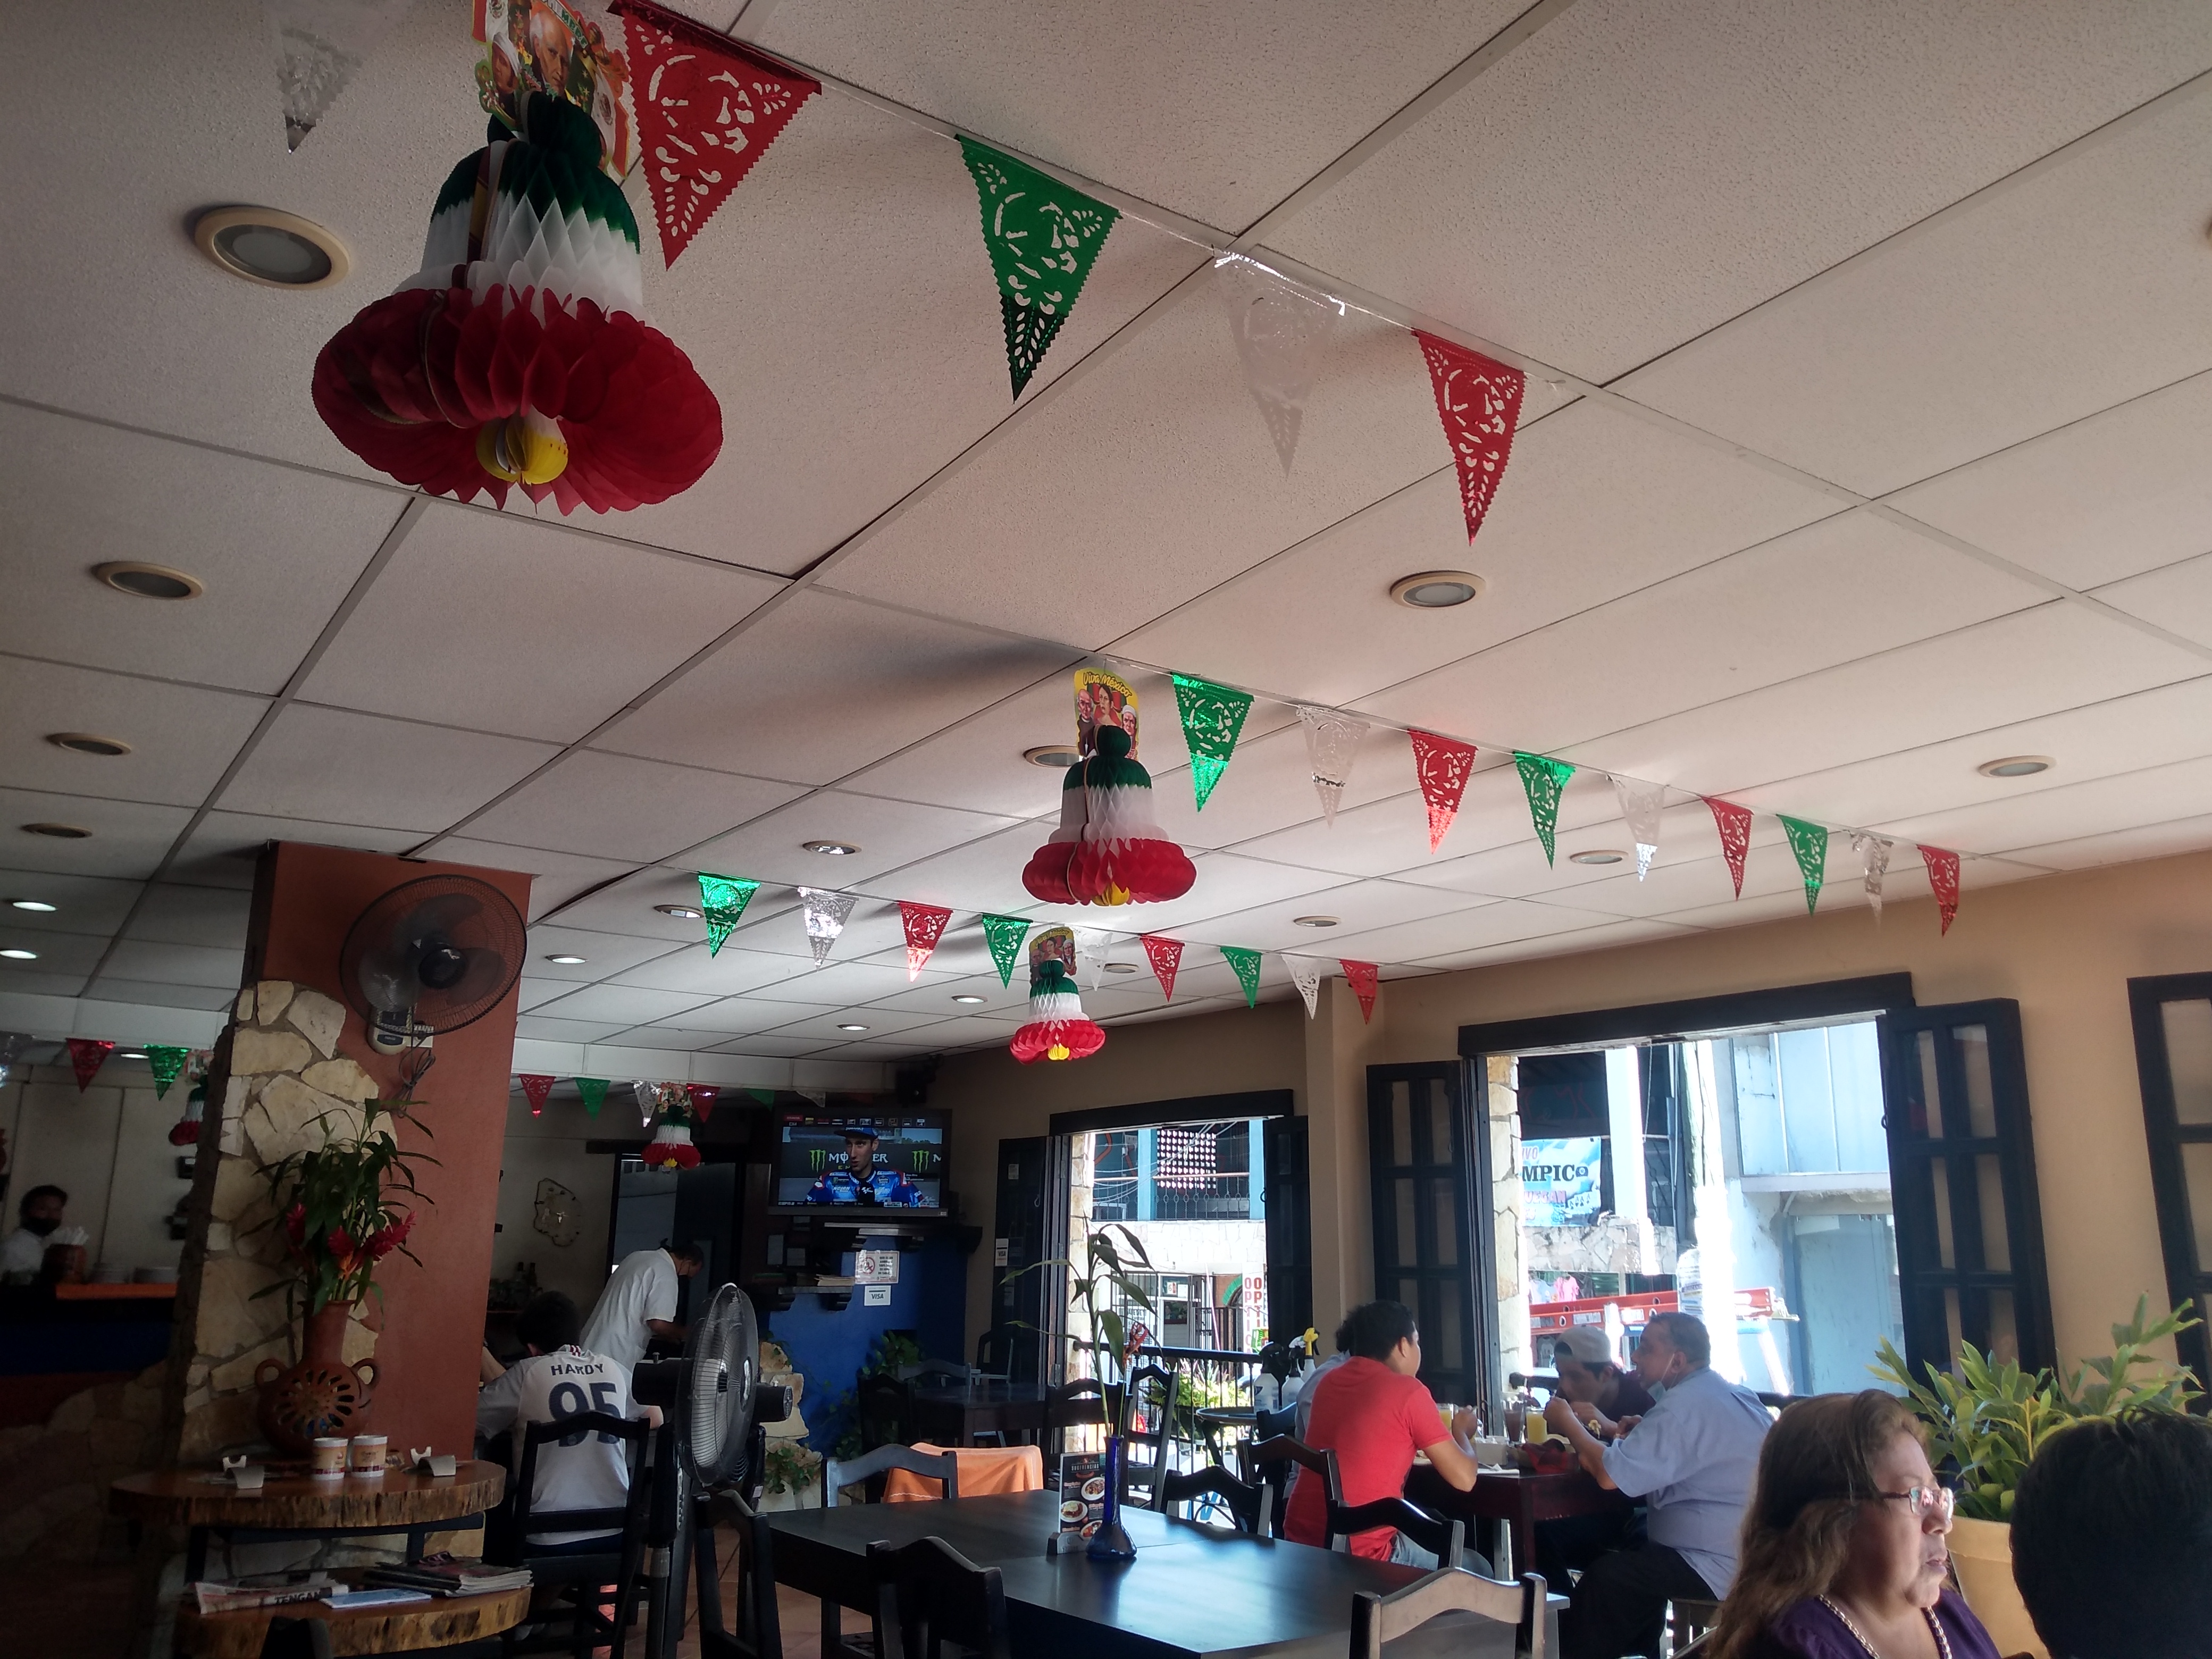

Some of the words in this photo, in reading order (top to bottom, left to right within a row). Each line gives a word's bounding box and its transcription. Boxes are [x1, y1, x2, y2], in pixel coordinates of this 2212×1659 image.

[1083, 672, 1101, 685] Viva
[1101, 674, 1132, 698] México
[550, 1363, 604, 1376] HARDY
